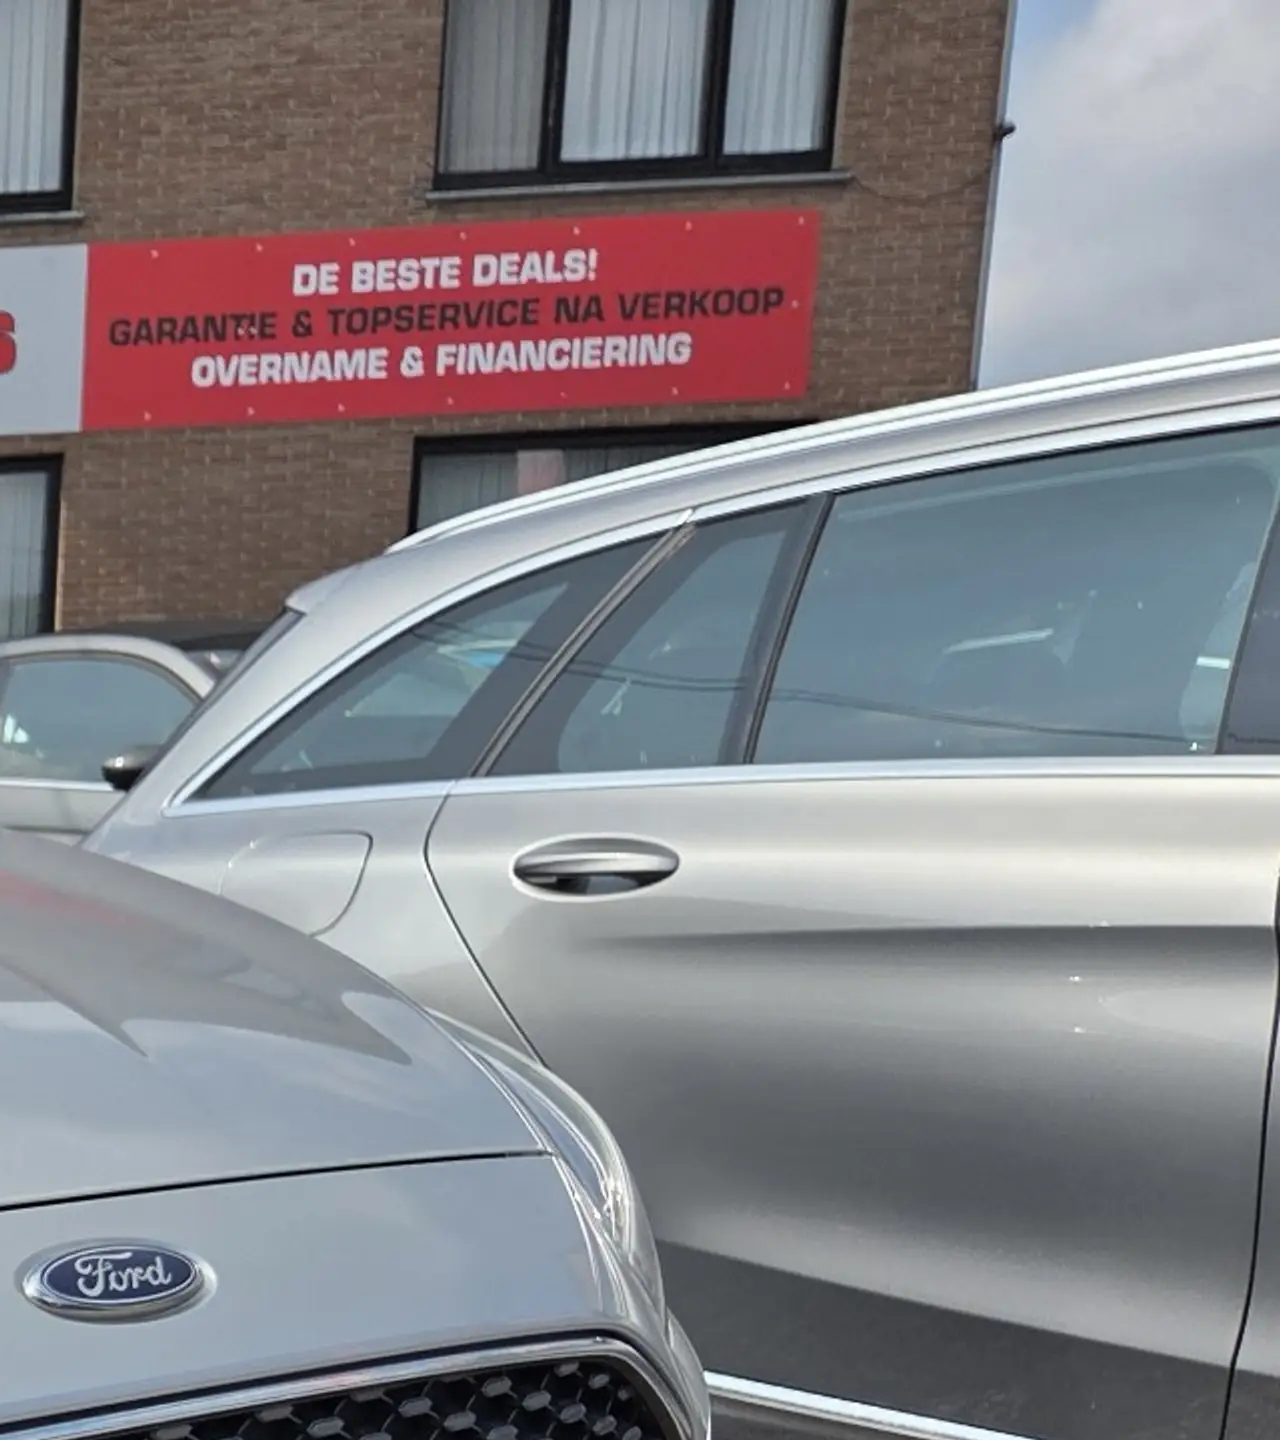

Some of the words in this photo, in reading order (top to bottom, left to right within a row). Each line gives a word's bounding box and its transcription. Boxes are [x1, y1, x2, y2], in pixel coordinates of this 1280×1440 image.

[292, 262, 340, 297] DE
[351, 255, 461, 293] BESTE
[472, 248, 598, 288] DEALS!
[108, 312, 277, 346] GARANTIE
[292, 309, 313, 338] &
[327, 299, 540, 336] TOPSERVICE
[554, 295, 604, 326] NA
[619, 287, 785, 321] VERKOOP
[191, 347, 389, 388] OVERNAME
[399, 345, 424, 378] &
[436, 331, 692, 376] FINANCIERING
[74, 1251, 172, 1297] Ford
